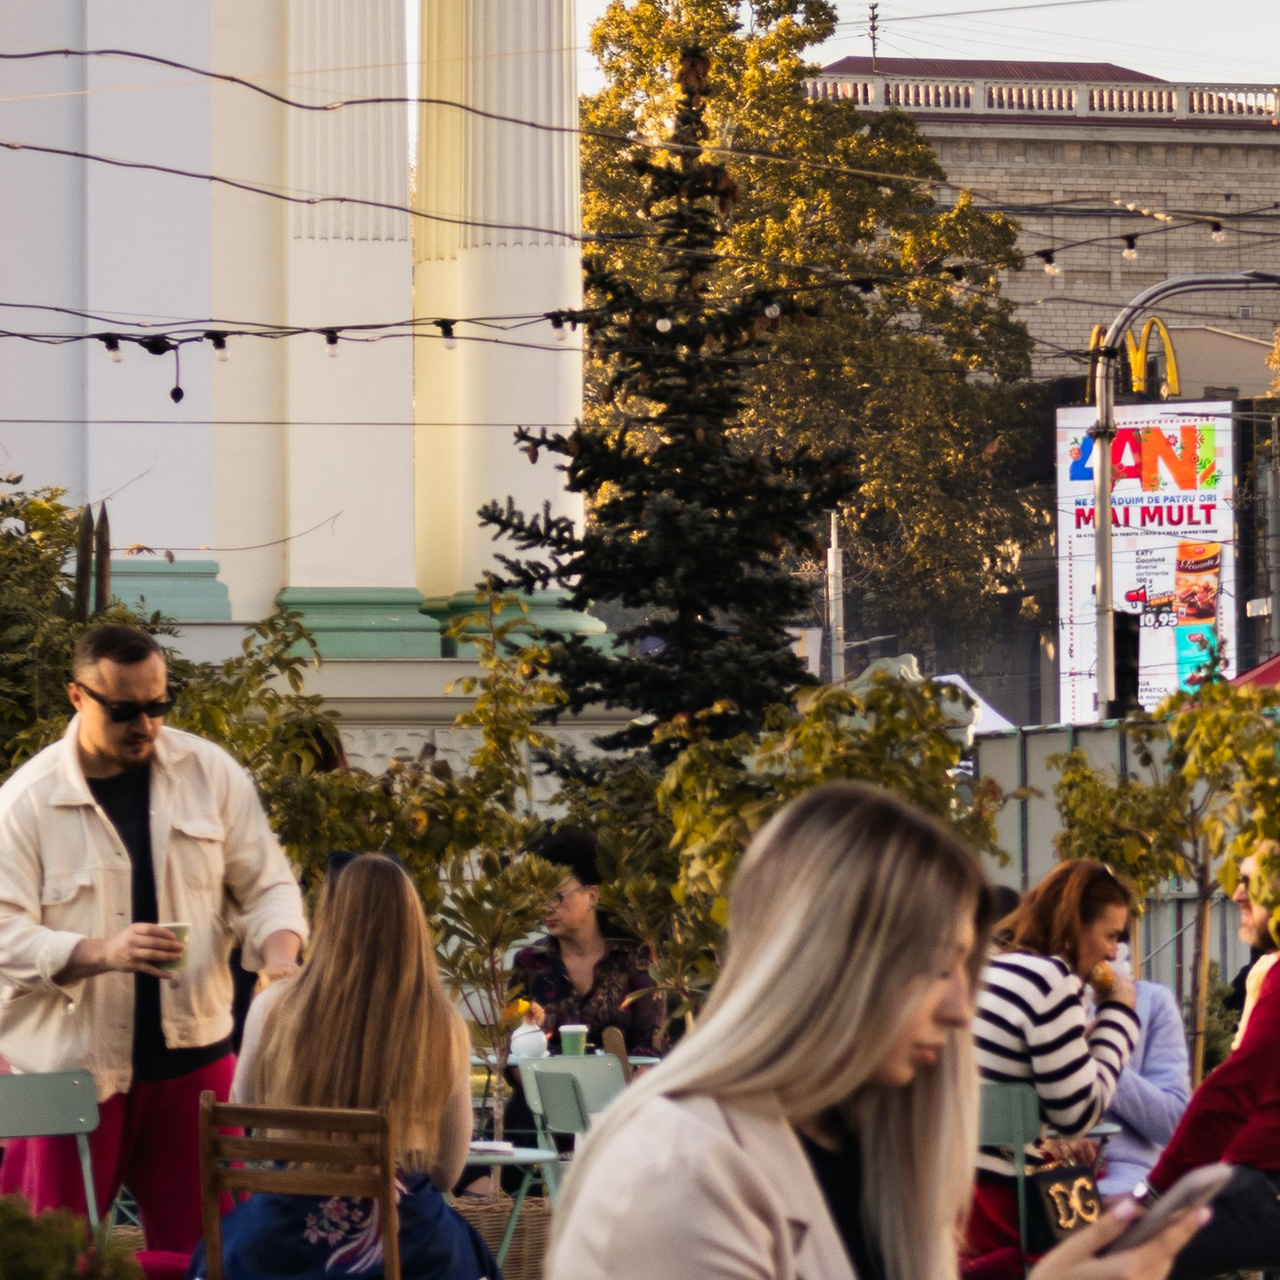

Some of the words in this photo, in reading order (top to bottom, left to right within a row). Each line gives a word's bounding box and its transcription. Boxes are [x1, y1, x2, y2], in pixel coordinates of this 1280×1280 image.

[1075, 498, 1088, 506] NE
[1091, 496, 1144, 506] SĂDUIM
[1147, 496, 1160, 504] DE
[1163, 495, 1196, 503] PATRU
[1199, 494, 1217, 503] ORI
[1140, 504, 1216, 527] MULT
[1140, 612, 1178, 629] 10,95
